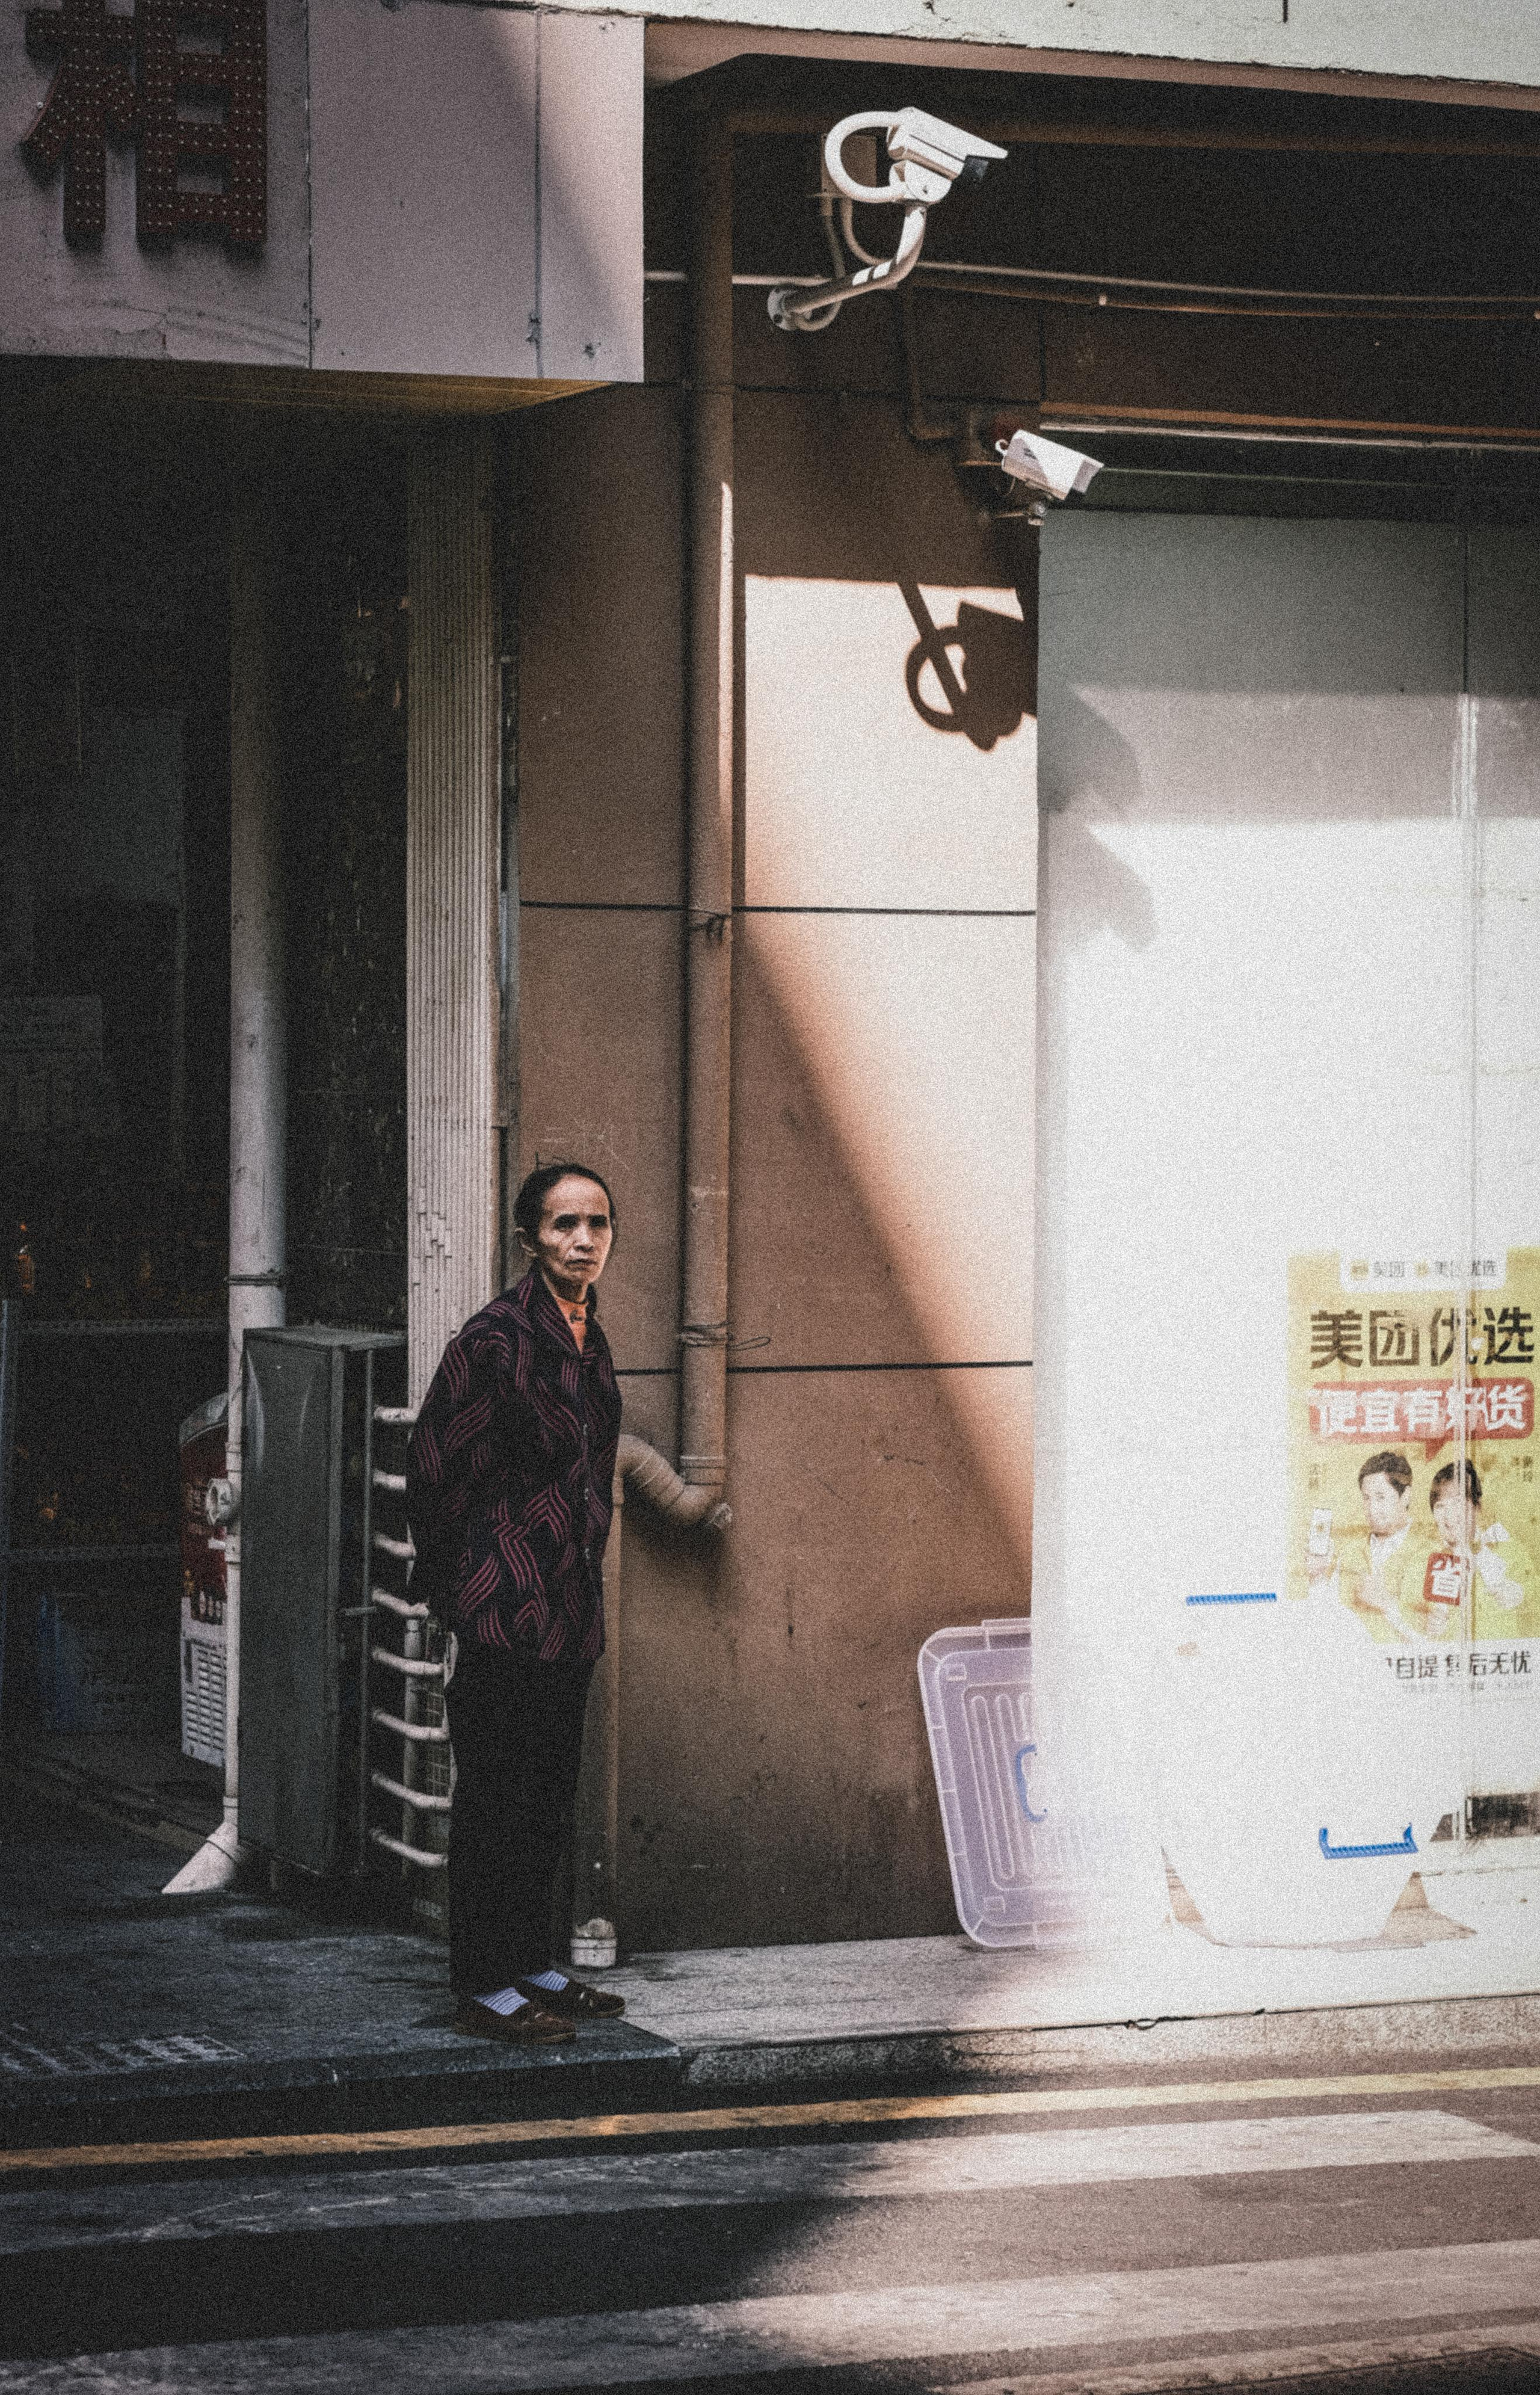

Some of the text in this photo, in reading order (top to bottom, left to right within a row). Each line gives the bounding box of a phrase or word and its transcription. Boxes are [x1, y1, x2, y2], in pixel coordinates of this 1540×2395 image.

[1310, 1307, 1535, 1369] 美团优选
[1308, 1385, 1529, 1437] 便宜有好货
[1431, 1558, 1463, 1599] 省
